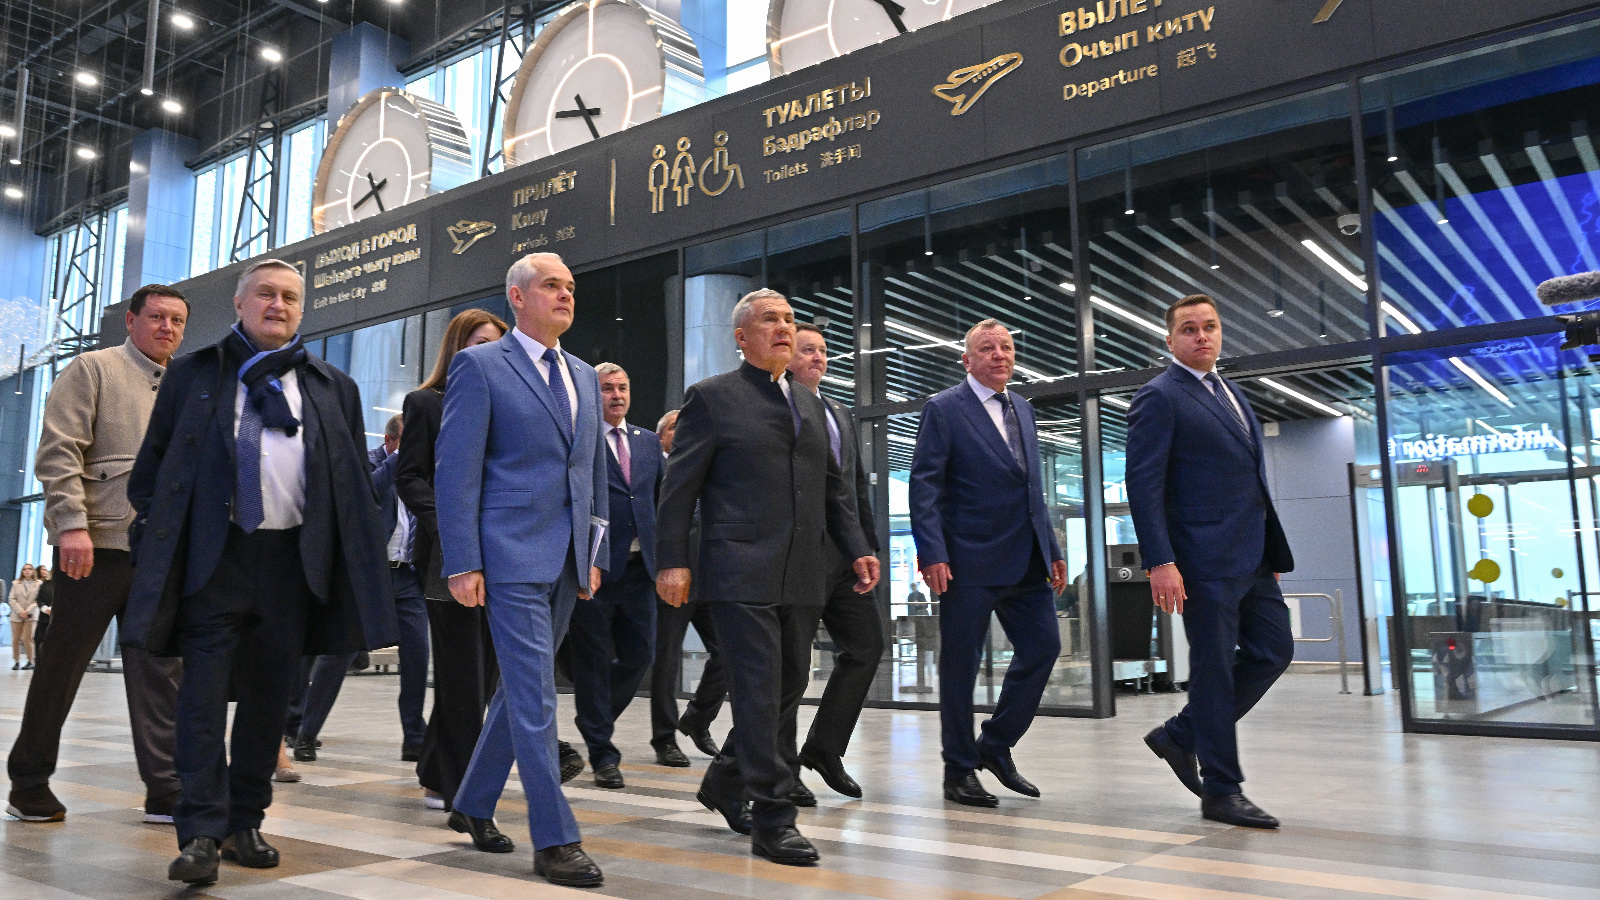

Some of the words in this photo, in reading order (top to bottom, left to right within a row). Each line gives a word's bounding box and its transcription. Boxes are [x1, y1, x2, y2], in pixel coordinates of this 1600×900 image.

[1059, 30, 1139, 67] Очып
[1146, 6, 1215, 43] китү
[762, 76, 871, 128] ТУАЛЕТЫ
[1063, 63, 1158, 101] Departure
[762, 109, 881, 157] Бәдрәфләр
[763, 162, 809, 184] Toilets
[820, 143, 862, 168] 洗手间
[512, 170, 578, 208] ПРИЛЁТ
[315, 242, 360, 269] ВЫХОД
[360, 238, 371, 255] В
[371, 223, 418, 251] ГОРОД
